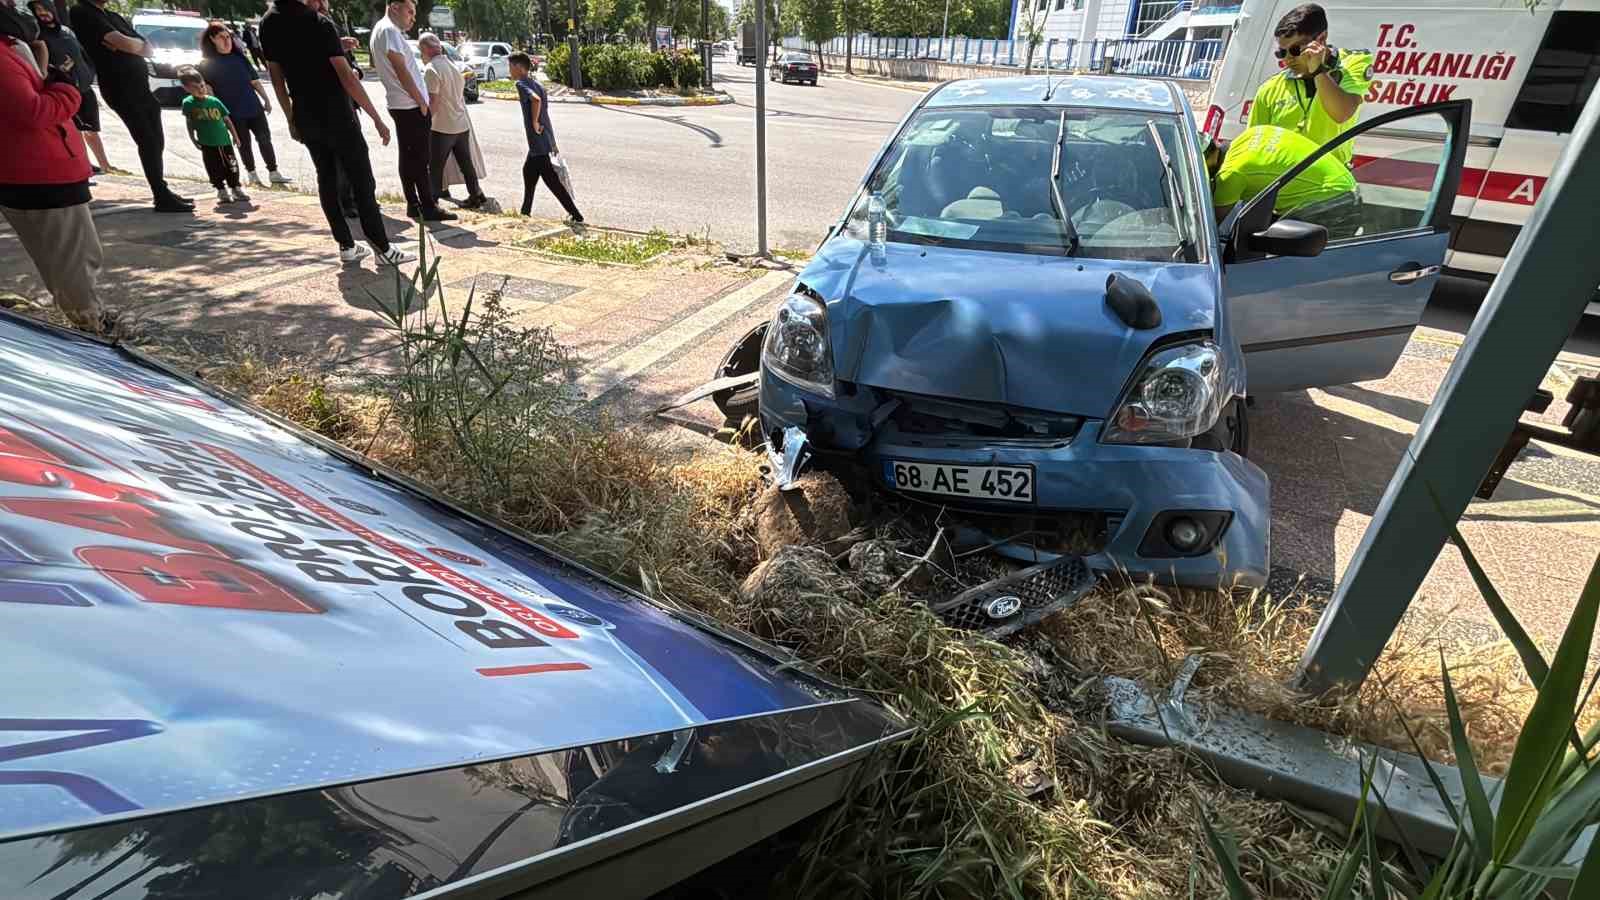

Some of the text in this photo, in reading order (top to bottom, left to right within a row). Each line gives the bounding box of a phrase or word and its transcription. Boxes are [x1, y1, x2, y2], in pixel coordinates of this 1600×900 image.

[1376, 23, 1417, 48] T.C.
[1373, 50, 1516, 81] BAKANLIĞI
[1364, 78, 1458, 109] SAĞLIK
[895, 464, 1030, 498] 68 AE 452
[198, 502, 380, 587] PROF.
[312, 538, 553, 649] BORA
